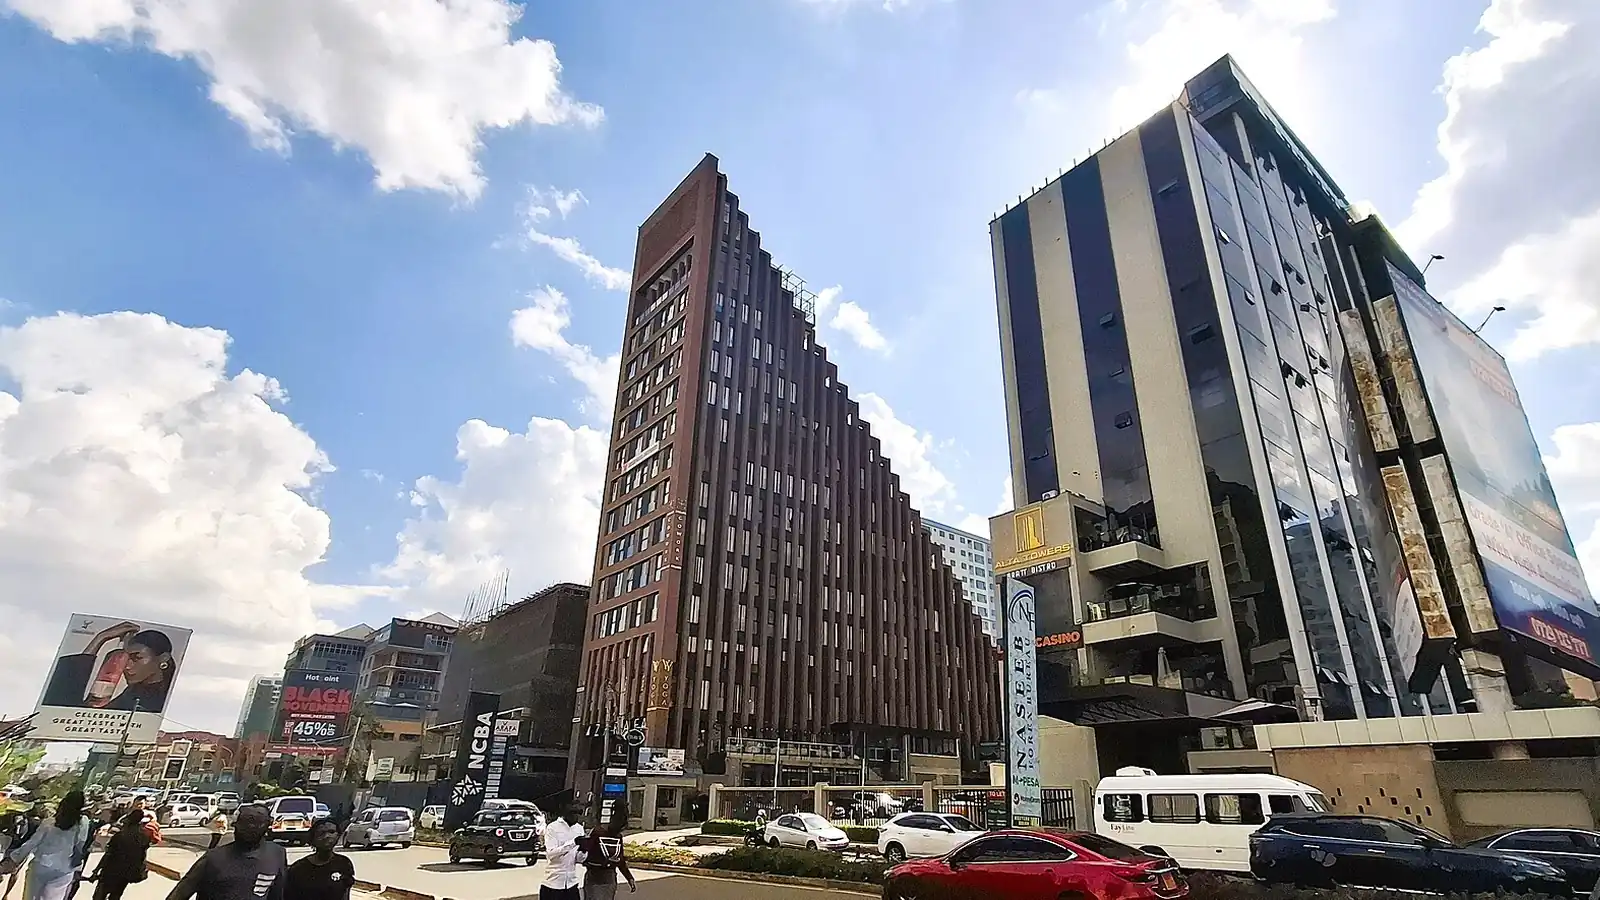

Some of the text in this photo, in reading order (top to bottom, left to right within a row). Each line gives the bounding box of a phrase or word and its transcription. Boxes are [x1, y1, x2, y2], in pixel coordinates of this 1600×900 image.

[675, 515, 683, 562] COWORK
[995, 543, 1071, 570] ALTA TOWERS
[1031, 562, 1056, 574] BISTRO
[1035, 631, 1081, 648] CASINO
[305, 673, 340, 682] Hotoint
[284, 686, 353, 704] BLACK
[661, 675, 669, 706] YOGA
[1013, 635, 1028, 770] NASEEB
[52, 717, 84, 725] GREAT
[75, 711, 127, 720] CELEBRATE
[293, 721, 328, 737] 45%
[326, 722, 337, 736] OFF
[468, 712, 493, 769] NCBA
